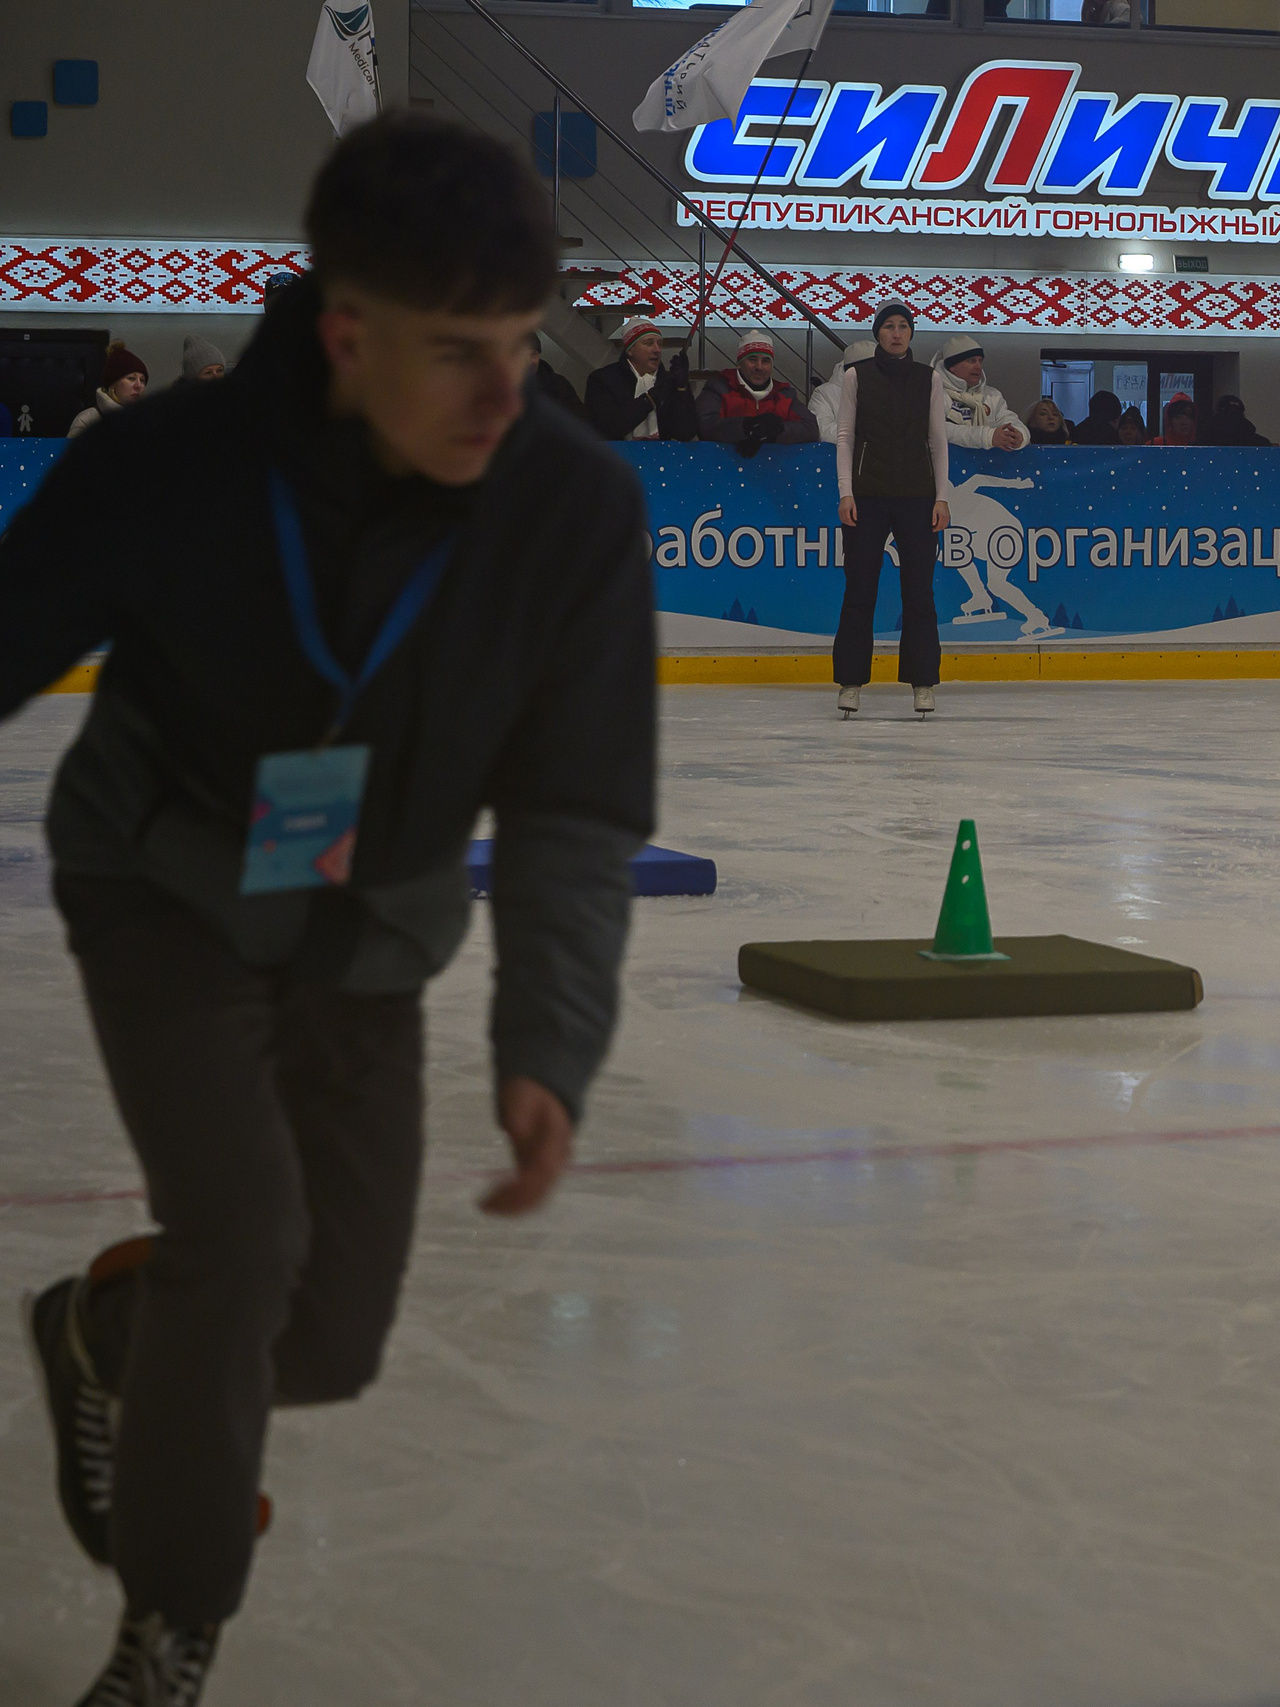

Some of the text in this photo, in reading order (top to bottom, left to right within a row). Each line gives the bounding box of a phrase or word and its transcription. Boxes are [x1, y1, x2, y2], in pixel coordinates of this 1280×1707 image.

[348, 41, 375, 85] Medical
[683, 199, 1027, 229] РЕСПУБЛИКАНСКИЙ
[1176, 259, 1208, 270] ВЫХОД
